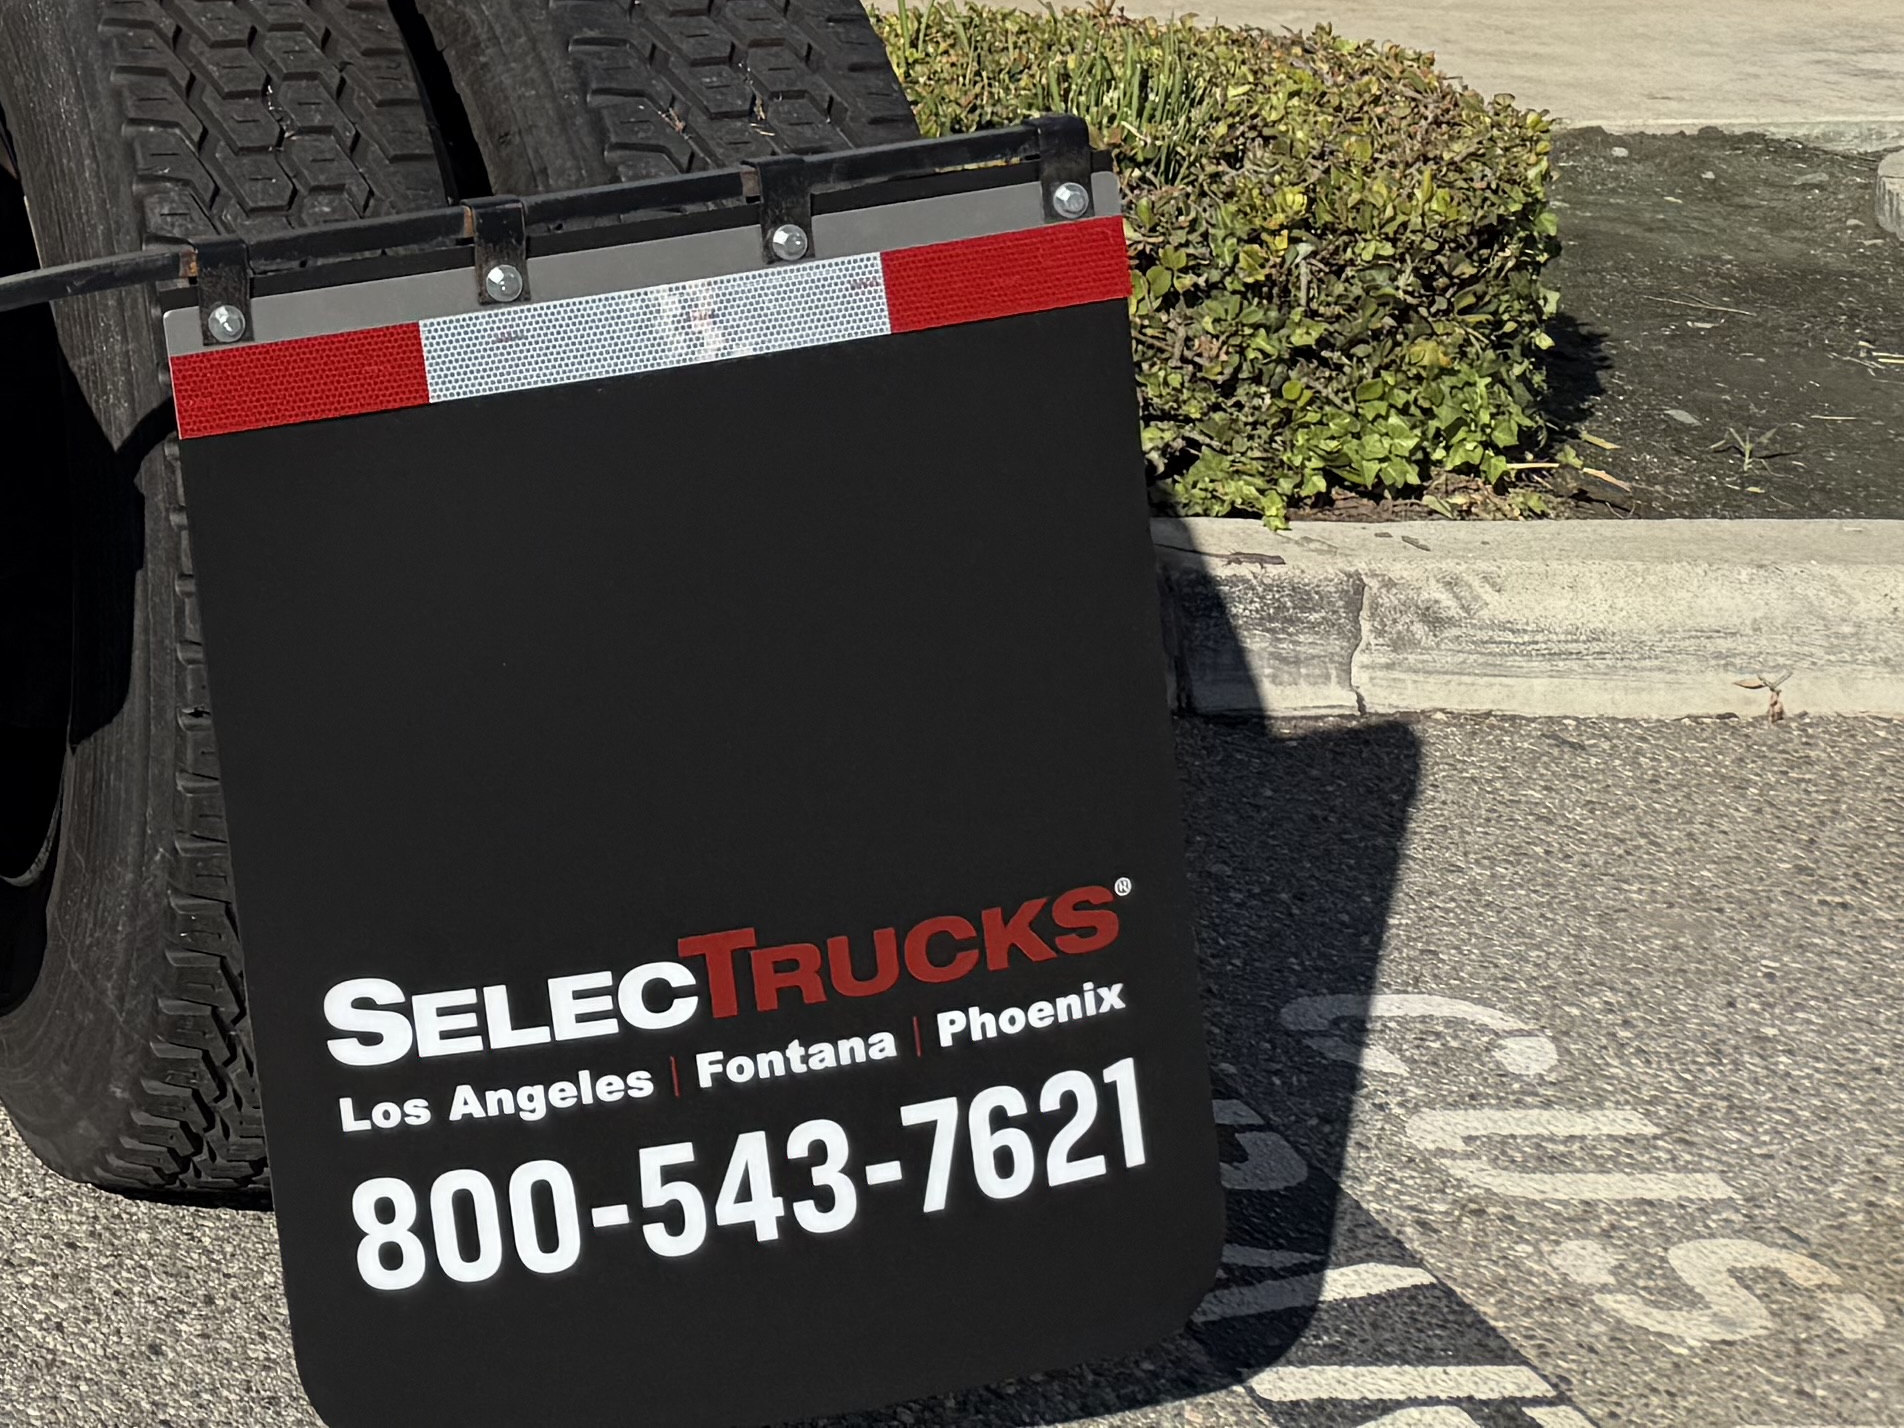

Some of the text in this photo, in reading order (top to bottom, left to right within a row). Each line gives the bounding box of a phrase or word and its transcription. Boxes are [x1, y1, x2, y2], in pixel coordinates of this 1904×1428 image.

[338, 981, 1127, 1133] Los Angeles Fontana Phoenix
[352, 1056, 1147, 1291] 800-543-7621
